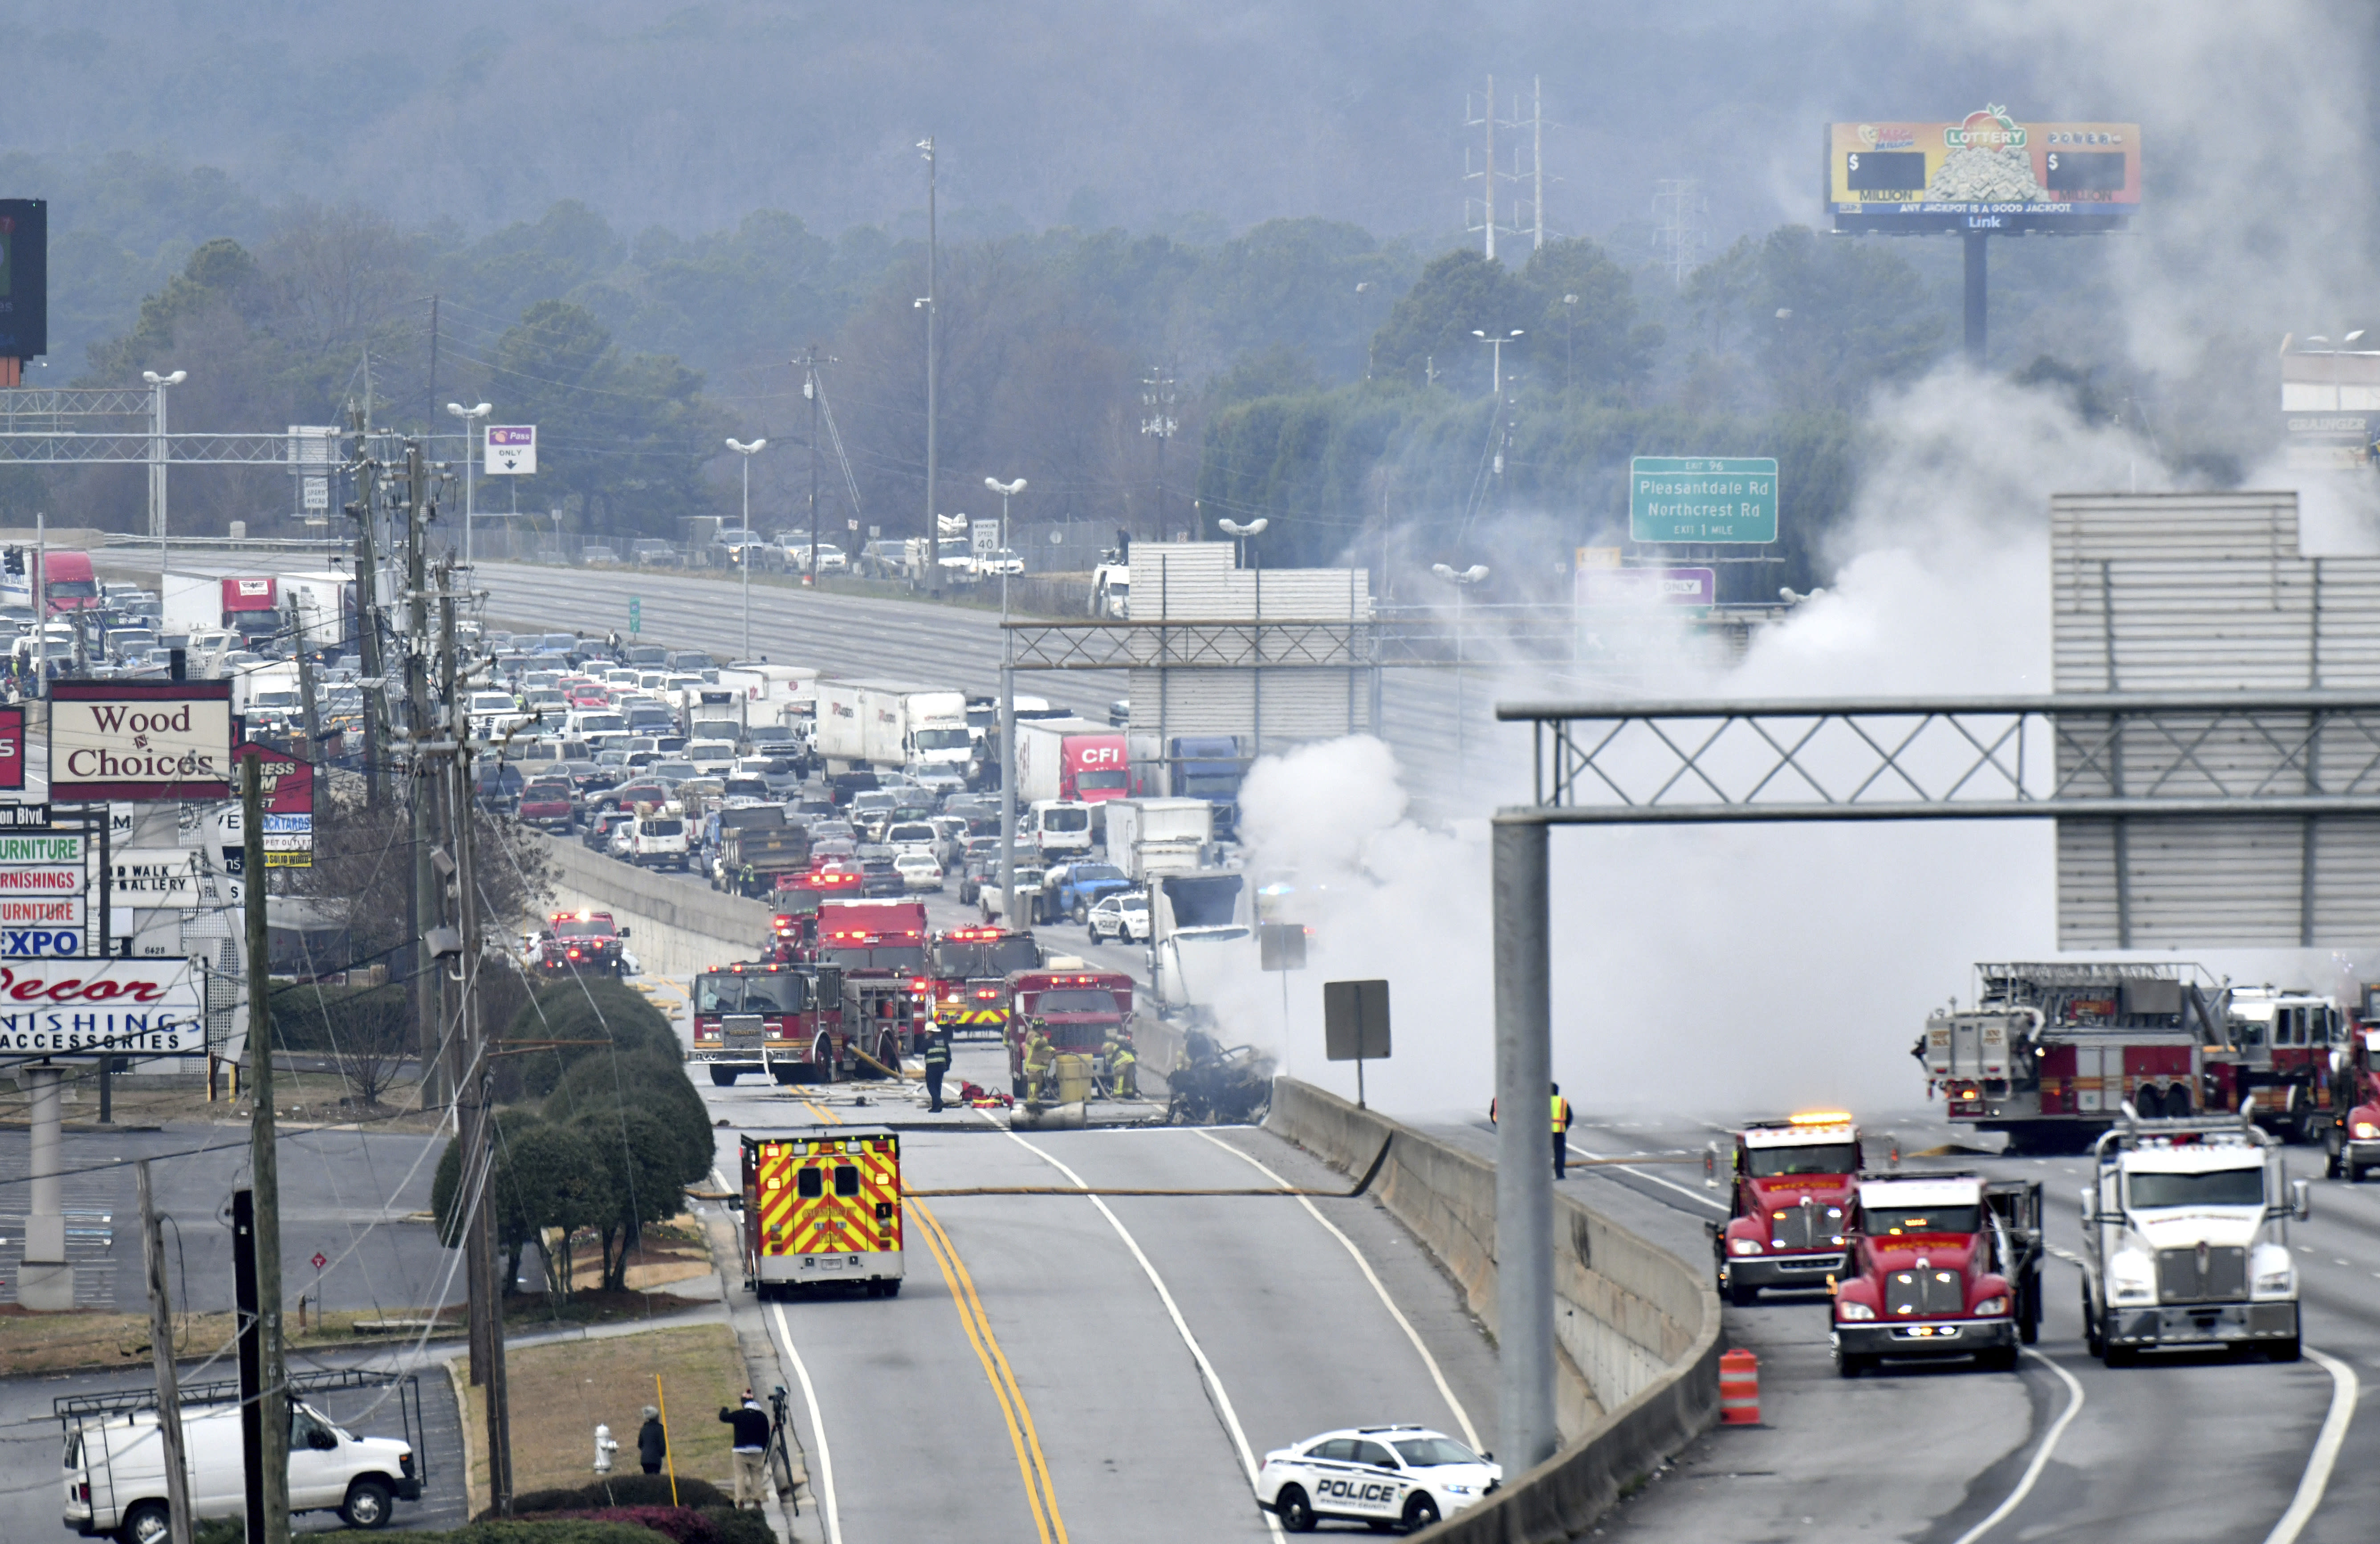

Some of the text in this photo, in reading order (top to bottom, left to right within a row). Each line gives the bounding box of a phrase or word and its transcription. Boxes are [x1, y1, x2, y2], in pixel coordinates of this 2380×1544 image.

[1950, 132, 2022, 143] LOTTERY
[1849, 154, 1859, 171] $
[2049, 154, 2058, 170] $
[1859, 190, 1913, 200] MILLION
[2060, 190, 2112, 200] MILLION
[1900, 204, 1921, 212] ANY
[1970, 204, 1979, 212] IS
[1981, 204, 1989, 212] A
[1991, 204, 2022, 212] GOOD
[1969, 216, 2001, 228] Link
[1709, 461, 1724, 471] 96
[1641, 481, 1768, 495] Pleasantdale Rd
[1648, 503, 1760, 517] Northcrest Rd
[1674, 524, 1733, 536] EXIT 1 MILE
[978, 539, 993, 549] 40
[1664, 582, 1694, 591] ONLY
[90, 705, 192, 733] Wood
[68, 746, 213, 777] Choices
[1082, 748, 1119, 763] CFI
[17, 807, 46, 824] Blvd.
[133, 866, 169, 877] WALK
[0, 872, 74, 888] RNISHINGS
[0, 903, 73, 920] URNITURE
[0, 1035, 179, 1049] ACCESSORIES
[882, 1207, 886, 1215] 1
[1317, 1479, 1395, 1502] POLICE
